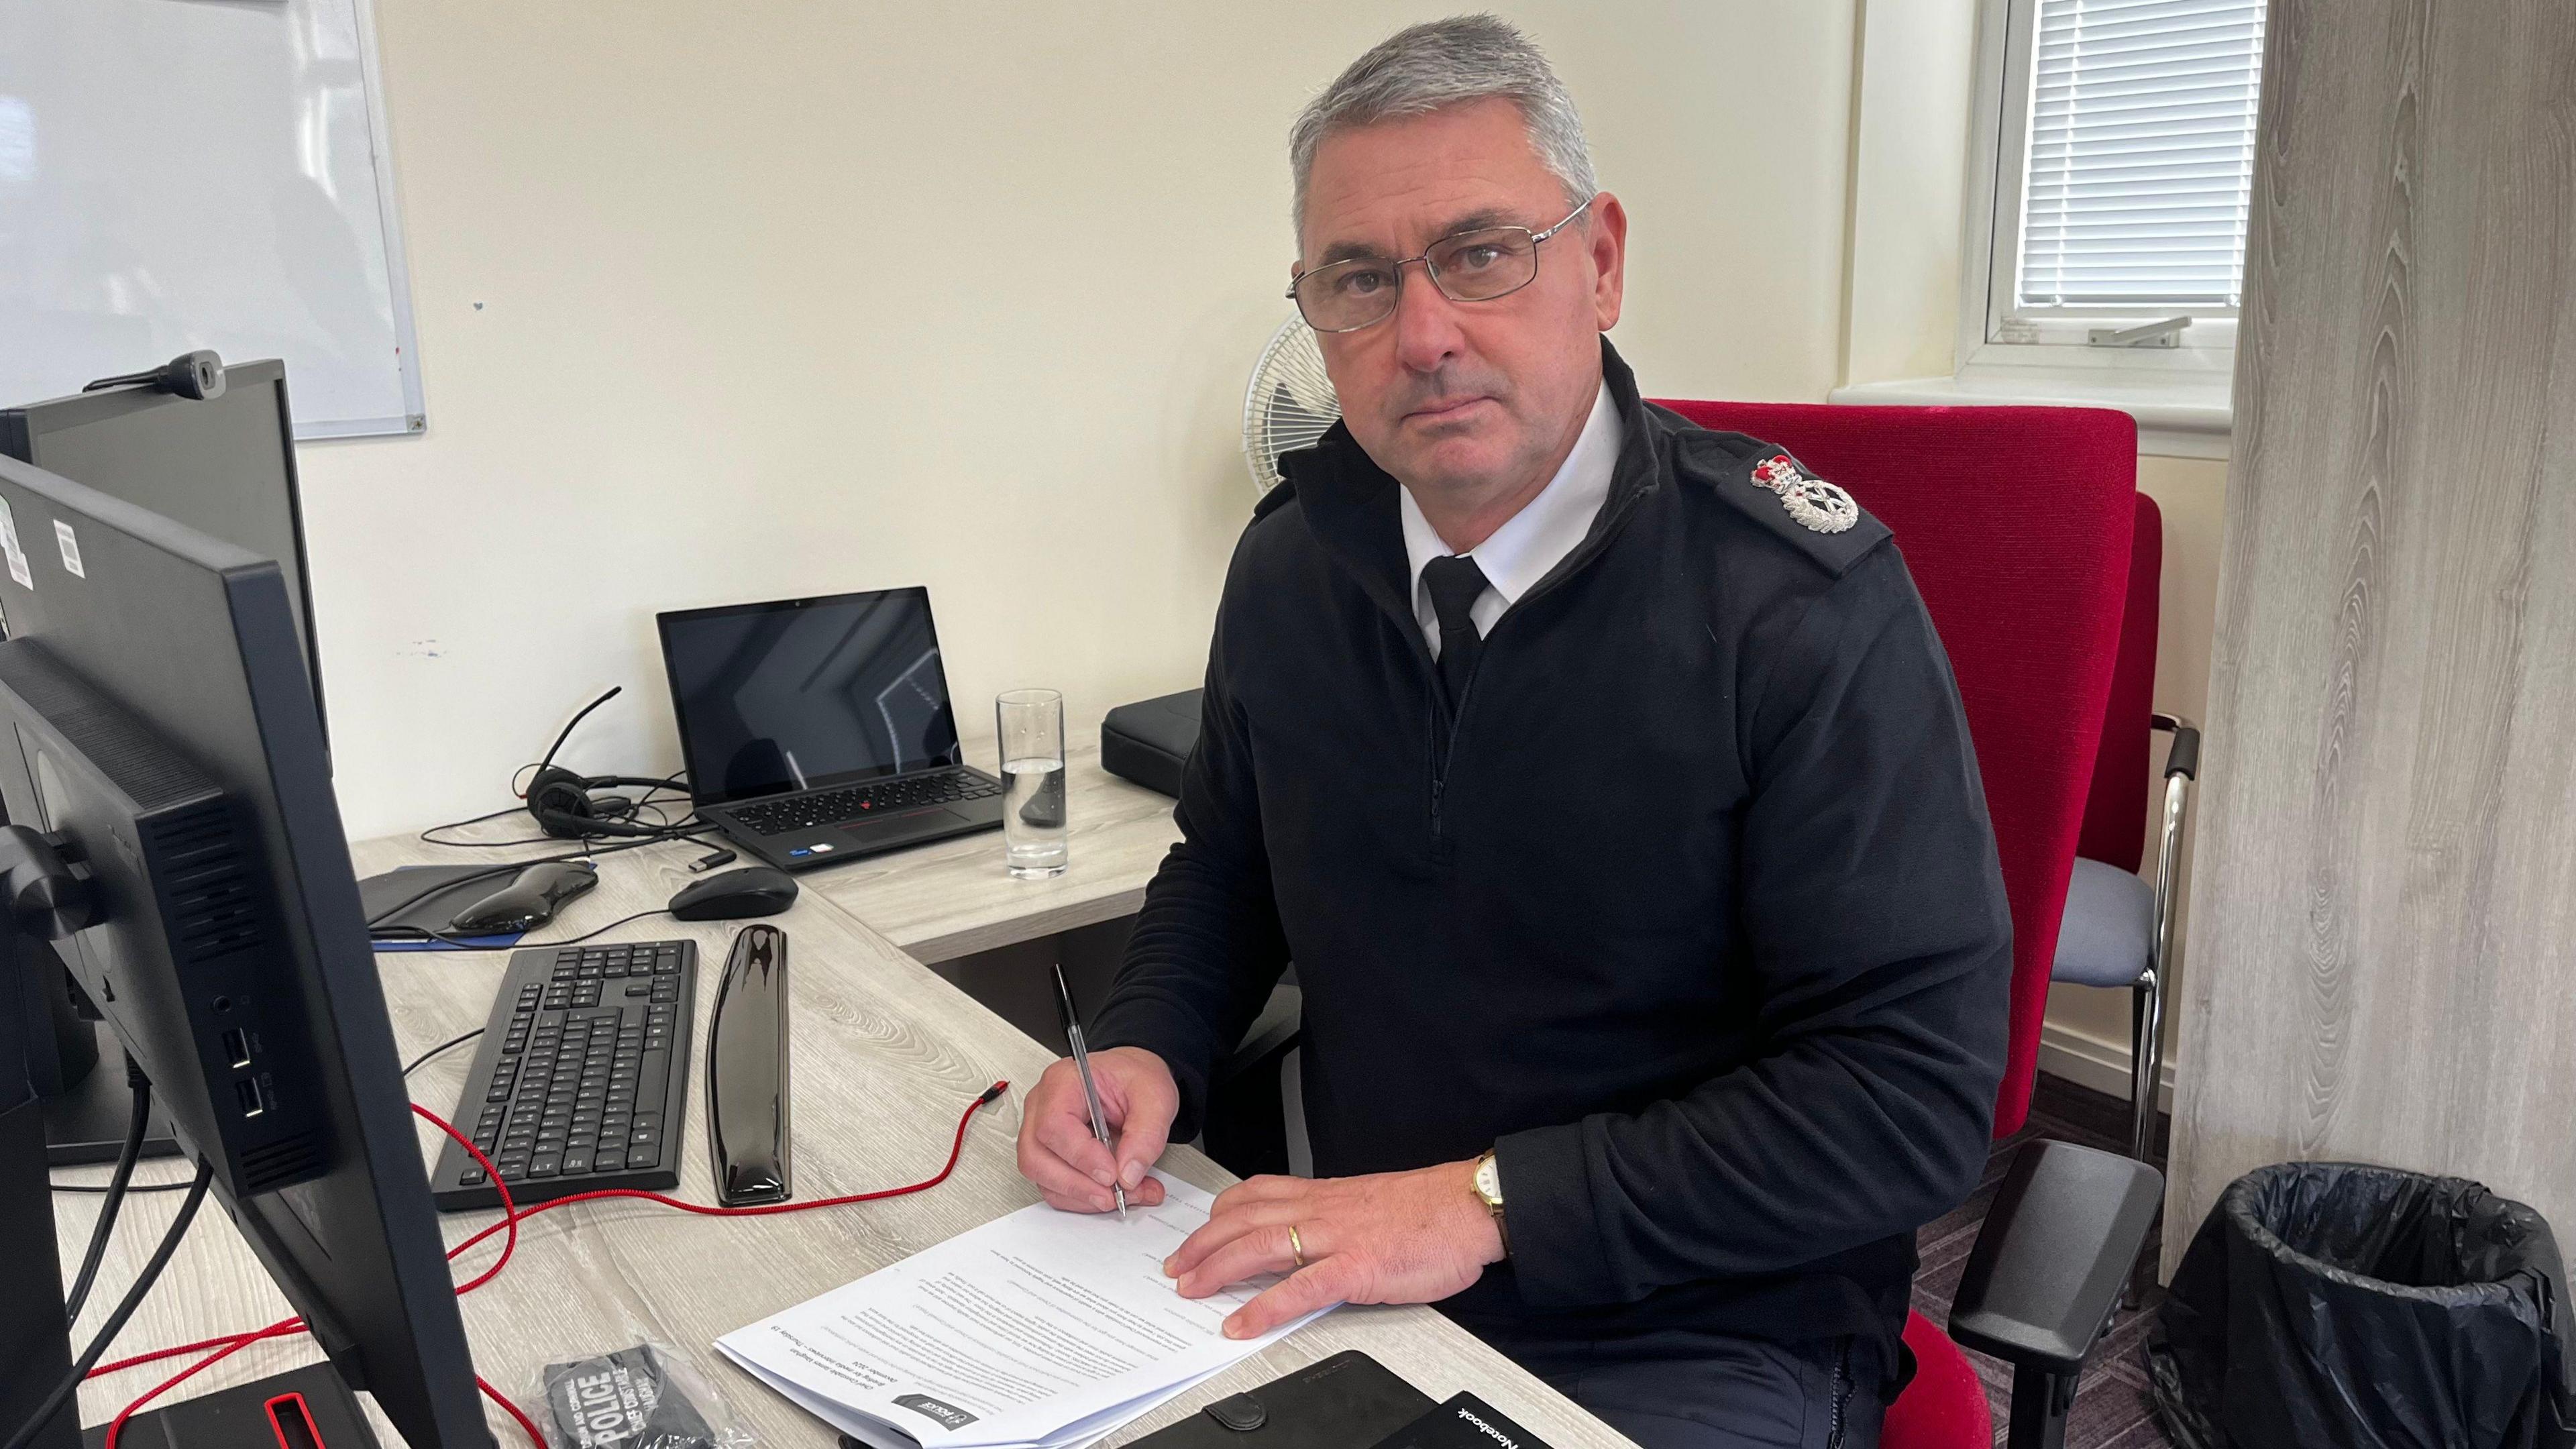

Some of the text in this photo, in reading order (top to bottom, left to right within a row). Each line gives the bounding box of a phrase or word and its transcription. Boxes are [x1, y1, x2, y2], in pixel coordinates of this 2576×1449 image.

[779, 1330, 804, 1346] Thursday
[790, 1348, 814, 1362] Vaughan
[806, 1347, 837, 1364] interviews
[812, 1360, 832, 1371] James
[851, 1361, 898, 1383] December 2024
[829, 1369, 858, 1383] Constable
[612, 1367, 646, 1432] CHIEF CONSTABLE
[564, 1379, 592, 1448] DEVON AND CORNWALL
[578, 1372, 629, 1445] POLICE
[921, 1402, 954, 1416] POLICE
[1457, 1407, 1518, 1449] Notebook
